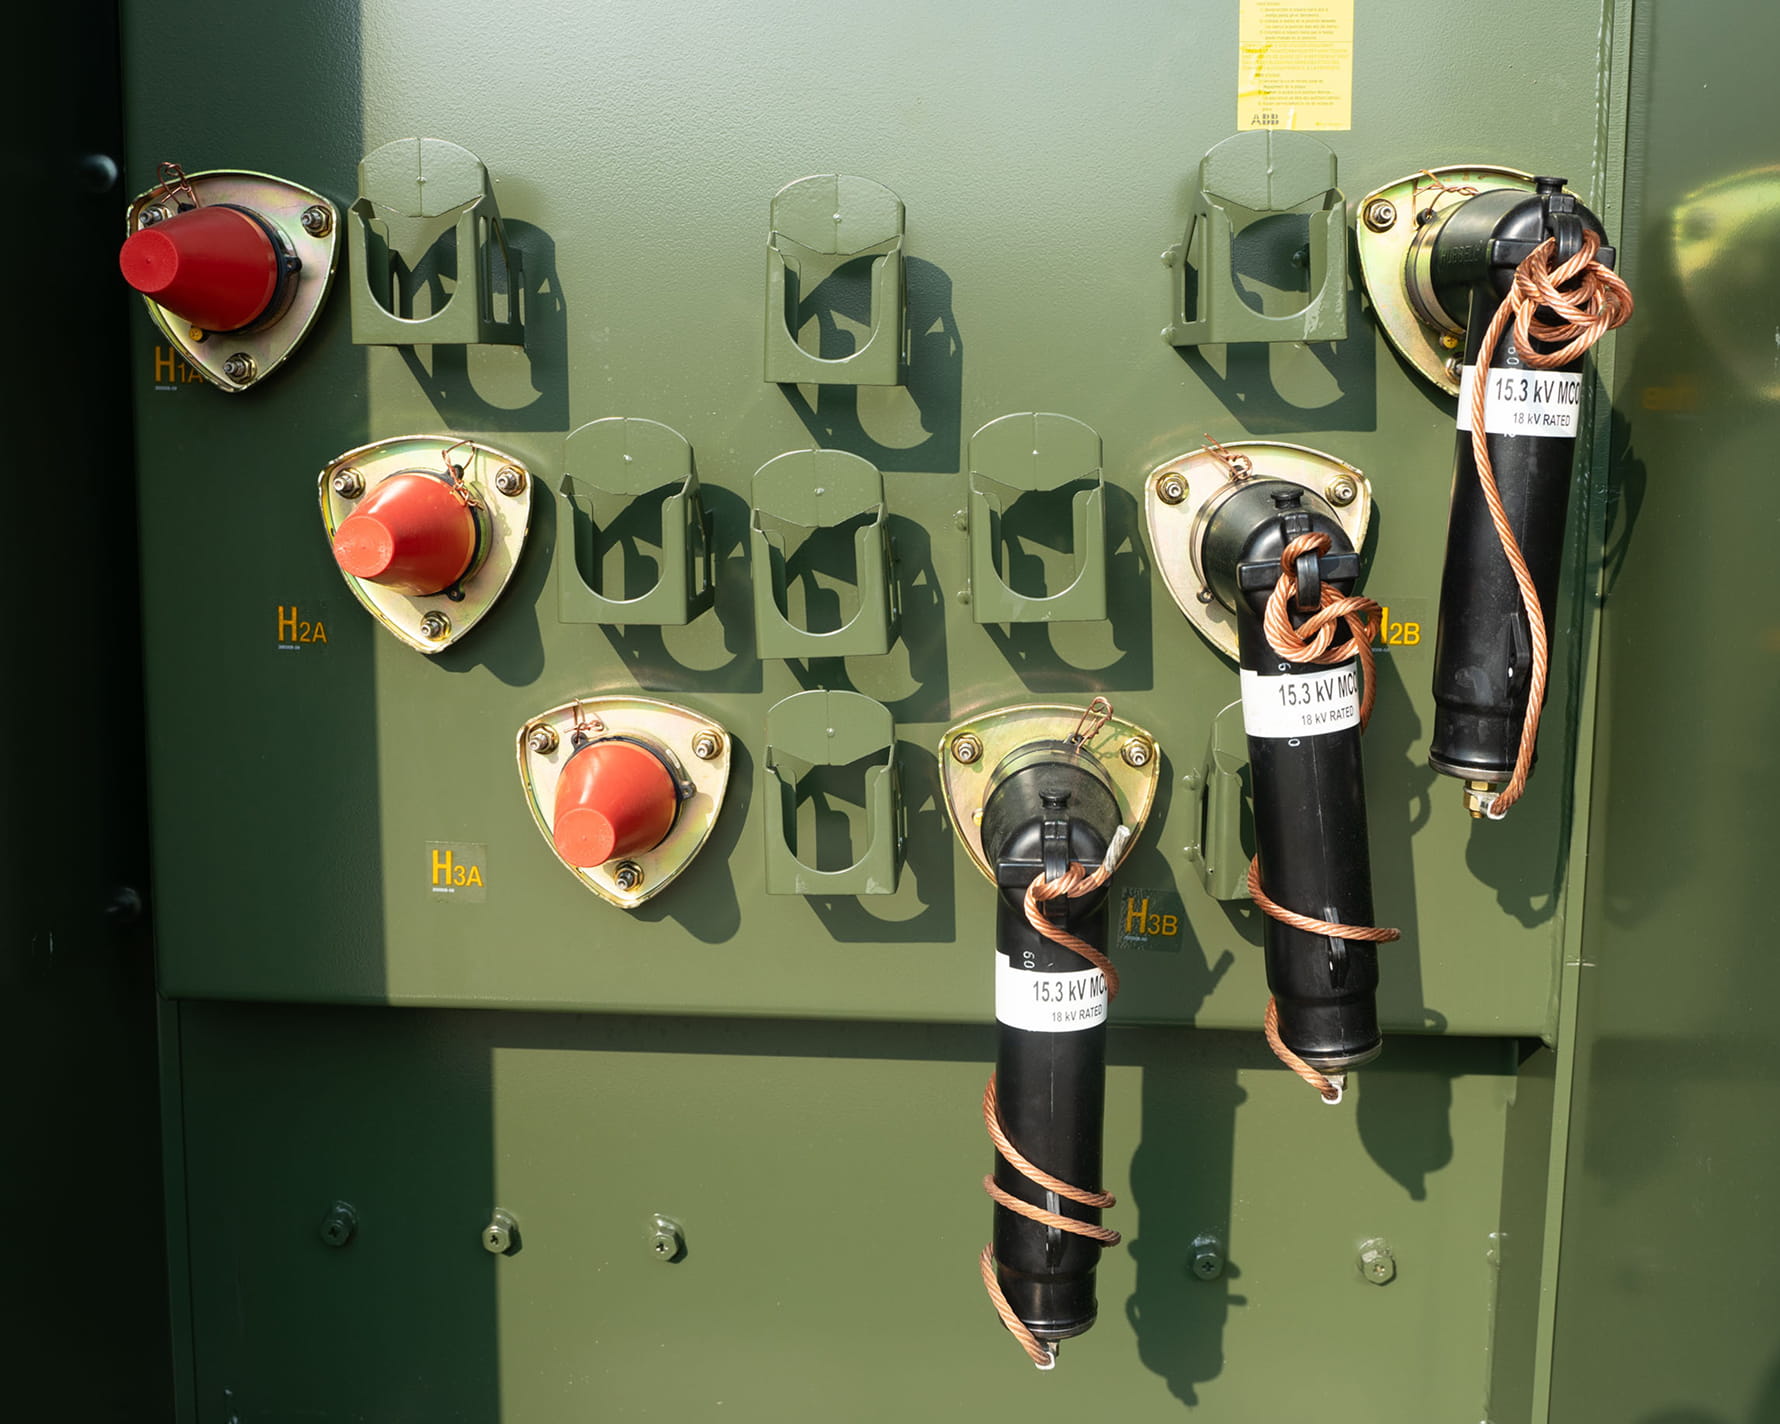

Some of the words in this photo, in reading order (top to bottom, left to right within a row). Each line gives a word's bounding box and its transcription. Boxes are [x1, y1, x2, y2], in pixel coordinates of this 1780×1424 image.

[1251, 113, 1280, 125] ABB
[155, 346, 203, 383] H1A
[1496, 378, 1528, 402] 15.3
[1533, 380, 1555, 403] kV
[1513, 412, 1525, 424] 18
[1528, 413, 1541, 425] kV
[1543, 413, 1571, 427] RATED
[278, 606, 328, 644] H2A
[1279, 682, 1311, 706] 15.3
[1315, 678, 1333, 703] kV
[1301, 714, 1313, 726] 18
[1315, 712, 1327, 724] kV
[1329, 705, 1354, 722] RATED
[432, 849, 484, 887] H3A
[1125, 897, 1178, 936] H3B
[1033, 980, 1063, 1002] 15.3
[1068, 979, 1086, 1001] kV
[1052, 1011, 1063, 1023] 18
[1065, 1010, 1077, 1022] kV
[1079, 1004, 1103, 1021] RATED
